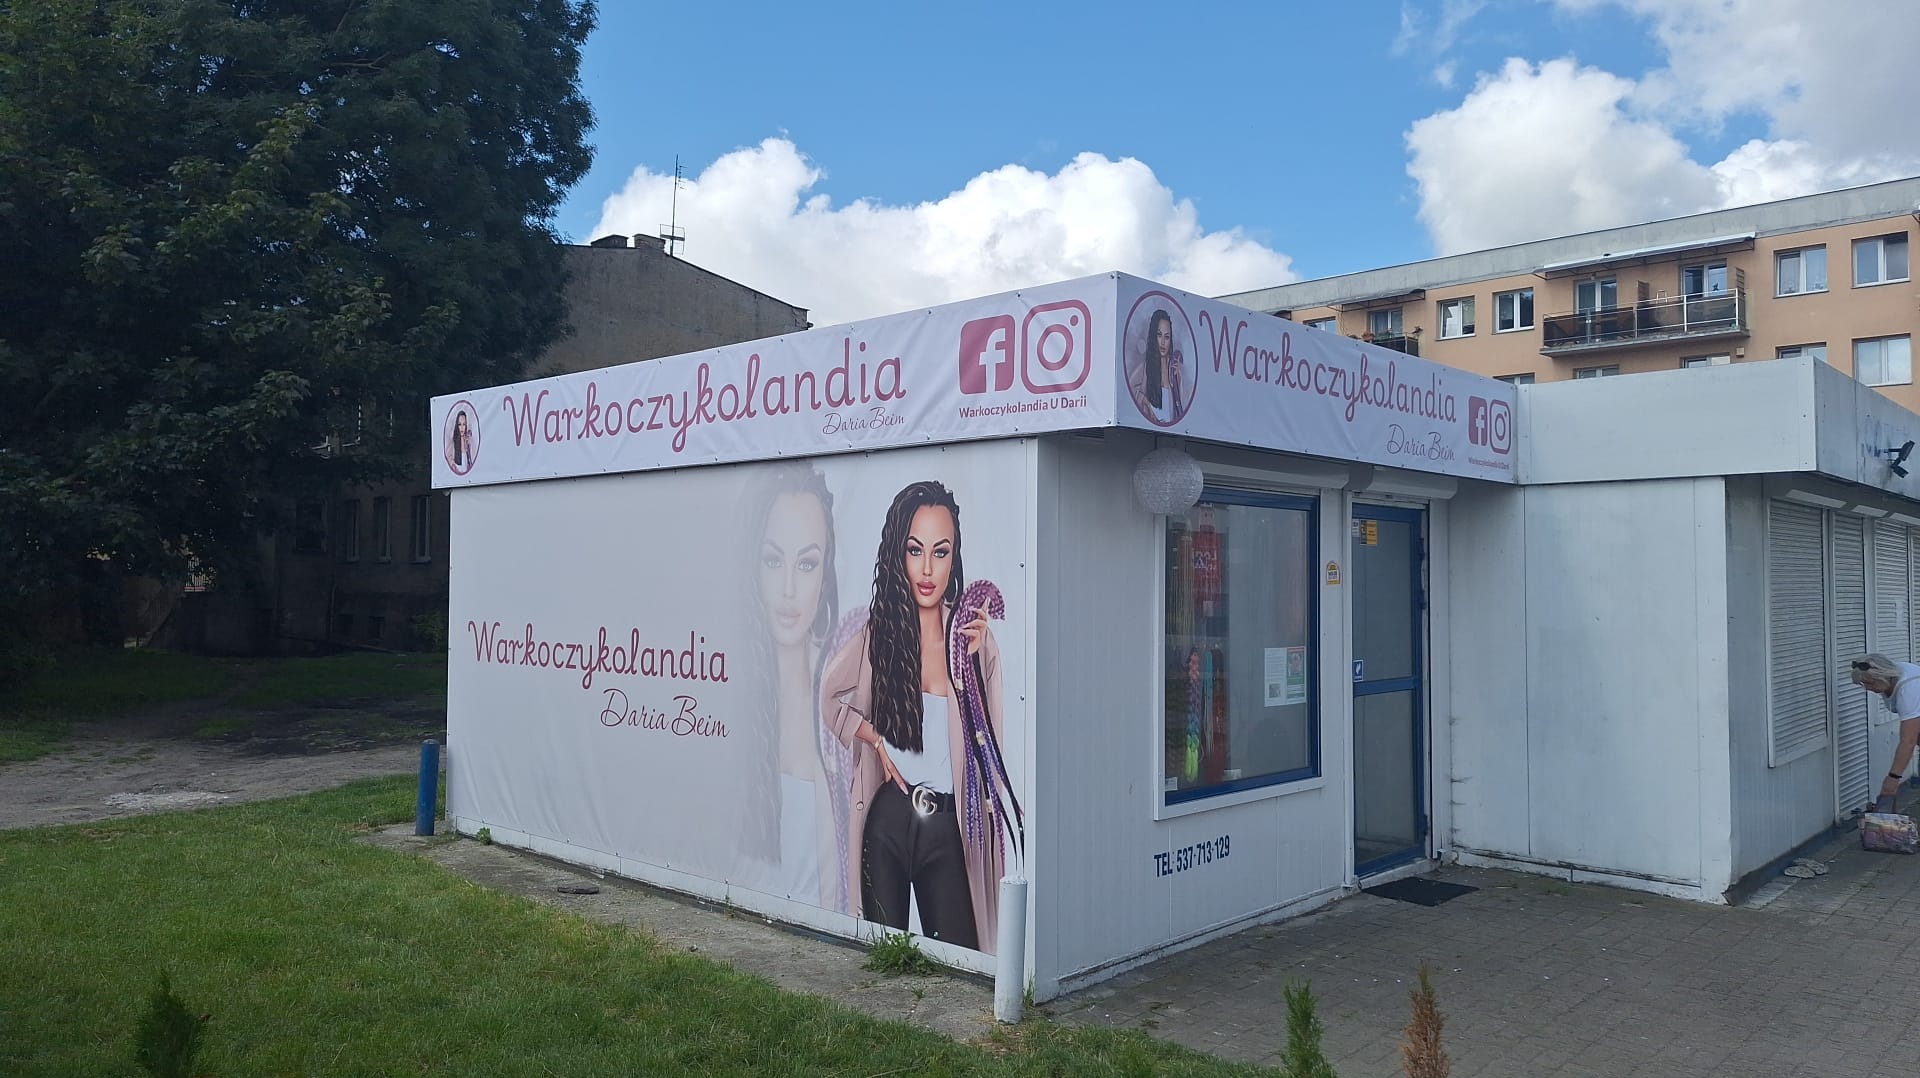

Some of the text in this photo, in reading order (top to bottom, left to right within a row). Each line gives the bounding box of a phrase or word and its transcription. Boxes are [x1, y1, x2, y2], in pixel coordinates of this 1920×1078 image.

[1199, 310, 1457, 423] Warkoczykolandia
[503, 337, 906, 453] Warkoczykolandia
[959, 395, 1087, 418] Warkoczykolandia U Darii
[822, 406, 905, 435] Daria Beim
[1386, 423, 1426, 456] Daria
[467, 620, 729, 690] Warkoczykolandia
[600, 688, 730, 738] Daria Beim
